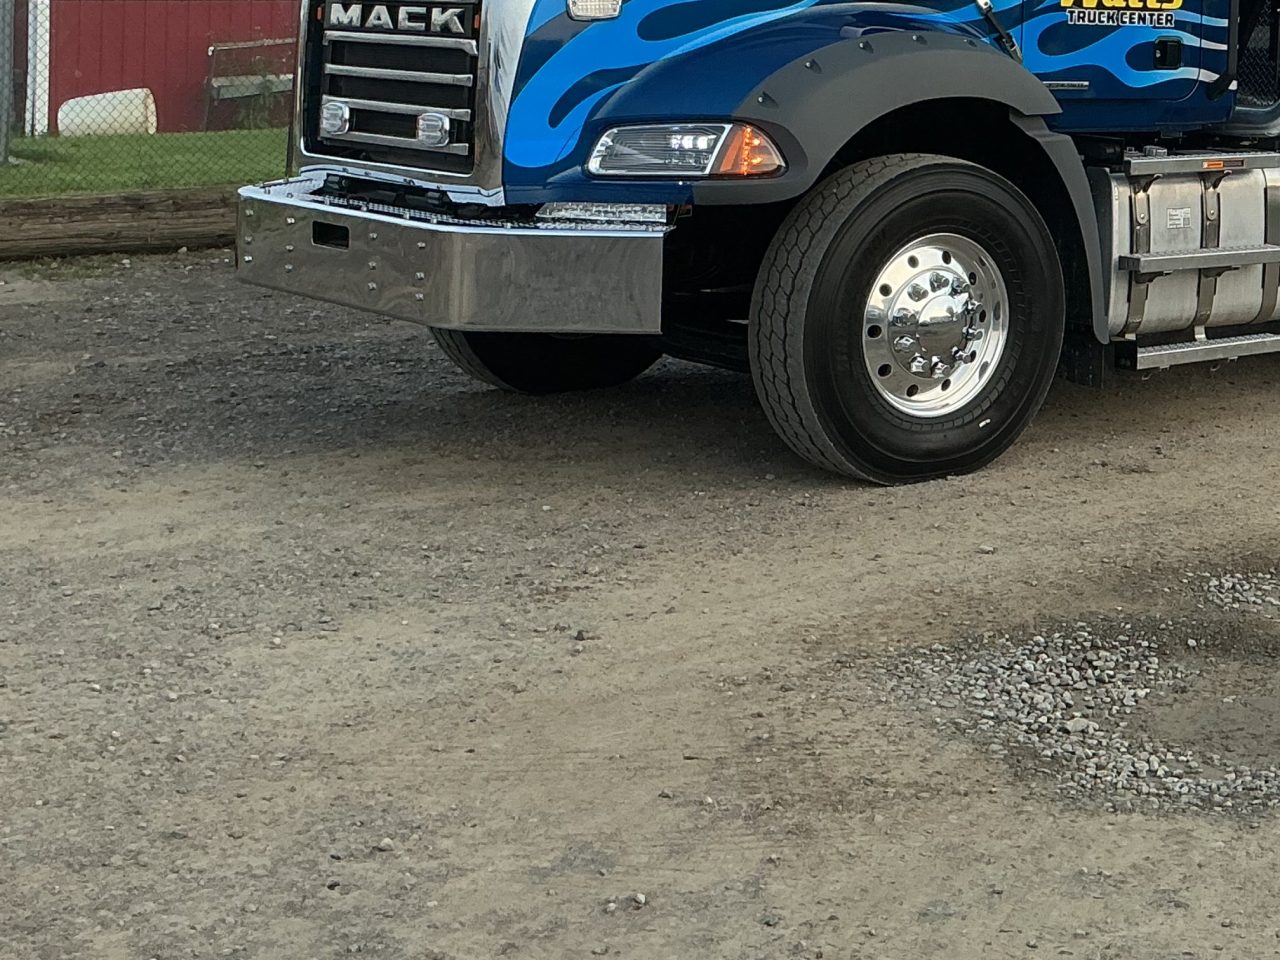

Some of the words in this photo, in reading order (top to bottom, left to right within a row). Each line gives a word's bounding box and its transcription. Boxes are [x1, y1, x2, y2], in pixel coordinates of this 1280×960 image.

[329, 3, 466, 35] MACK
[1067, 9, 1118, 25] TRUCK
[1118, 10, 1175, 27] CENTER
